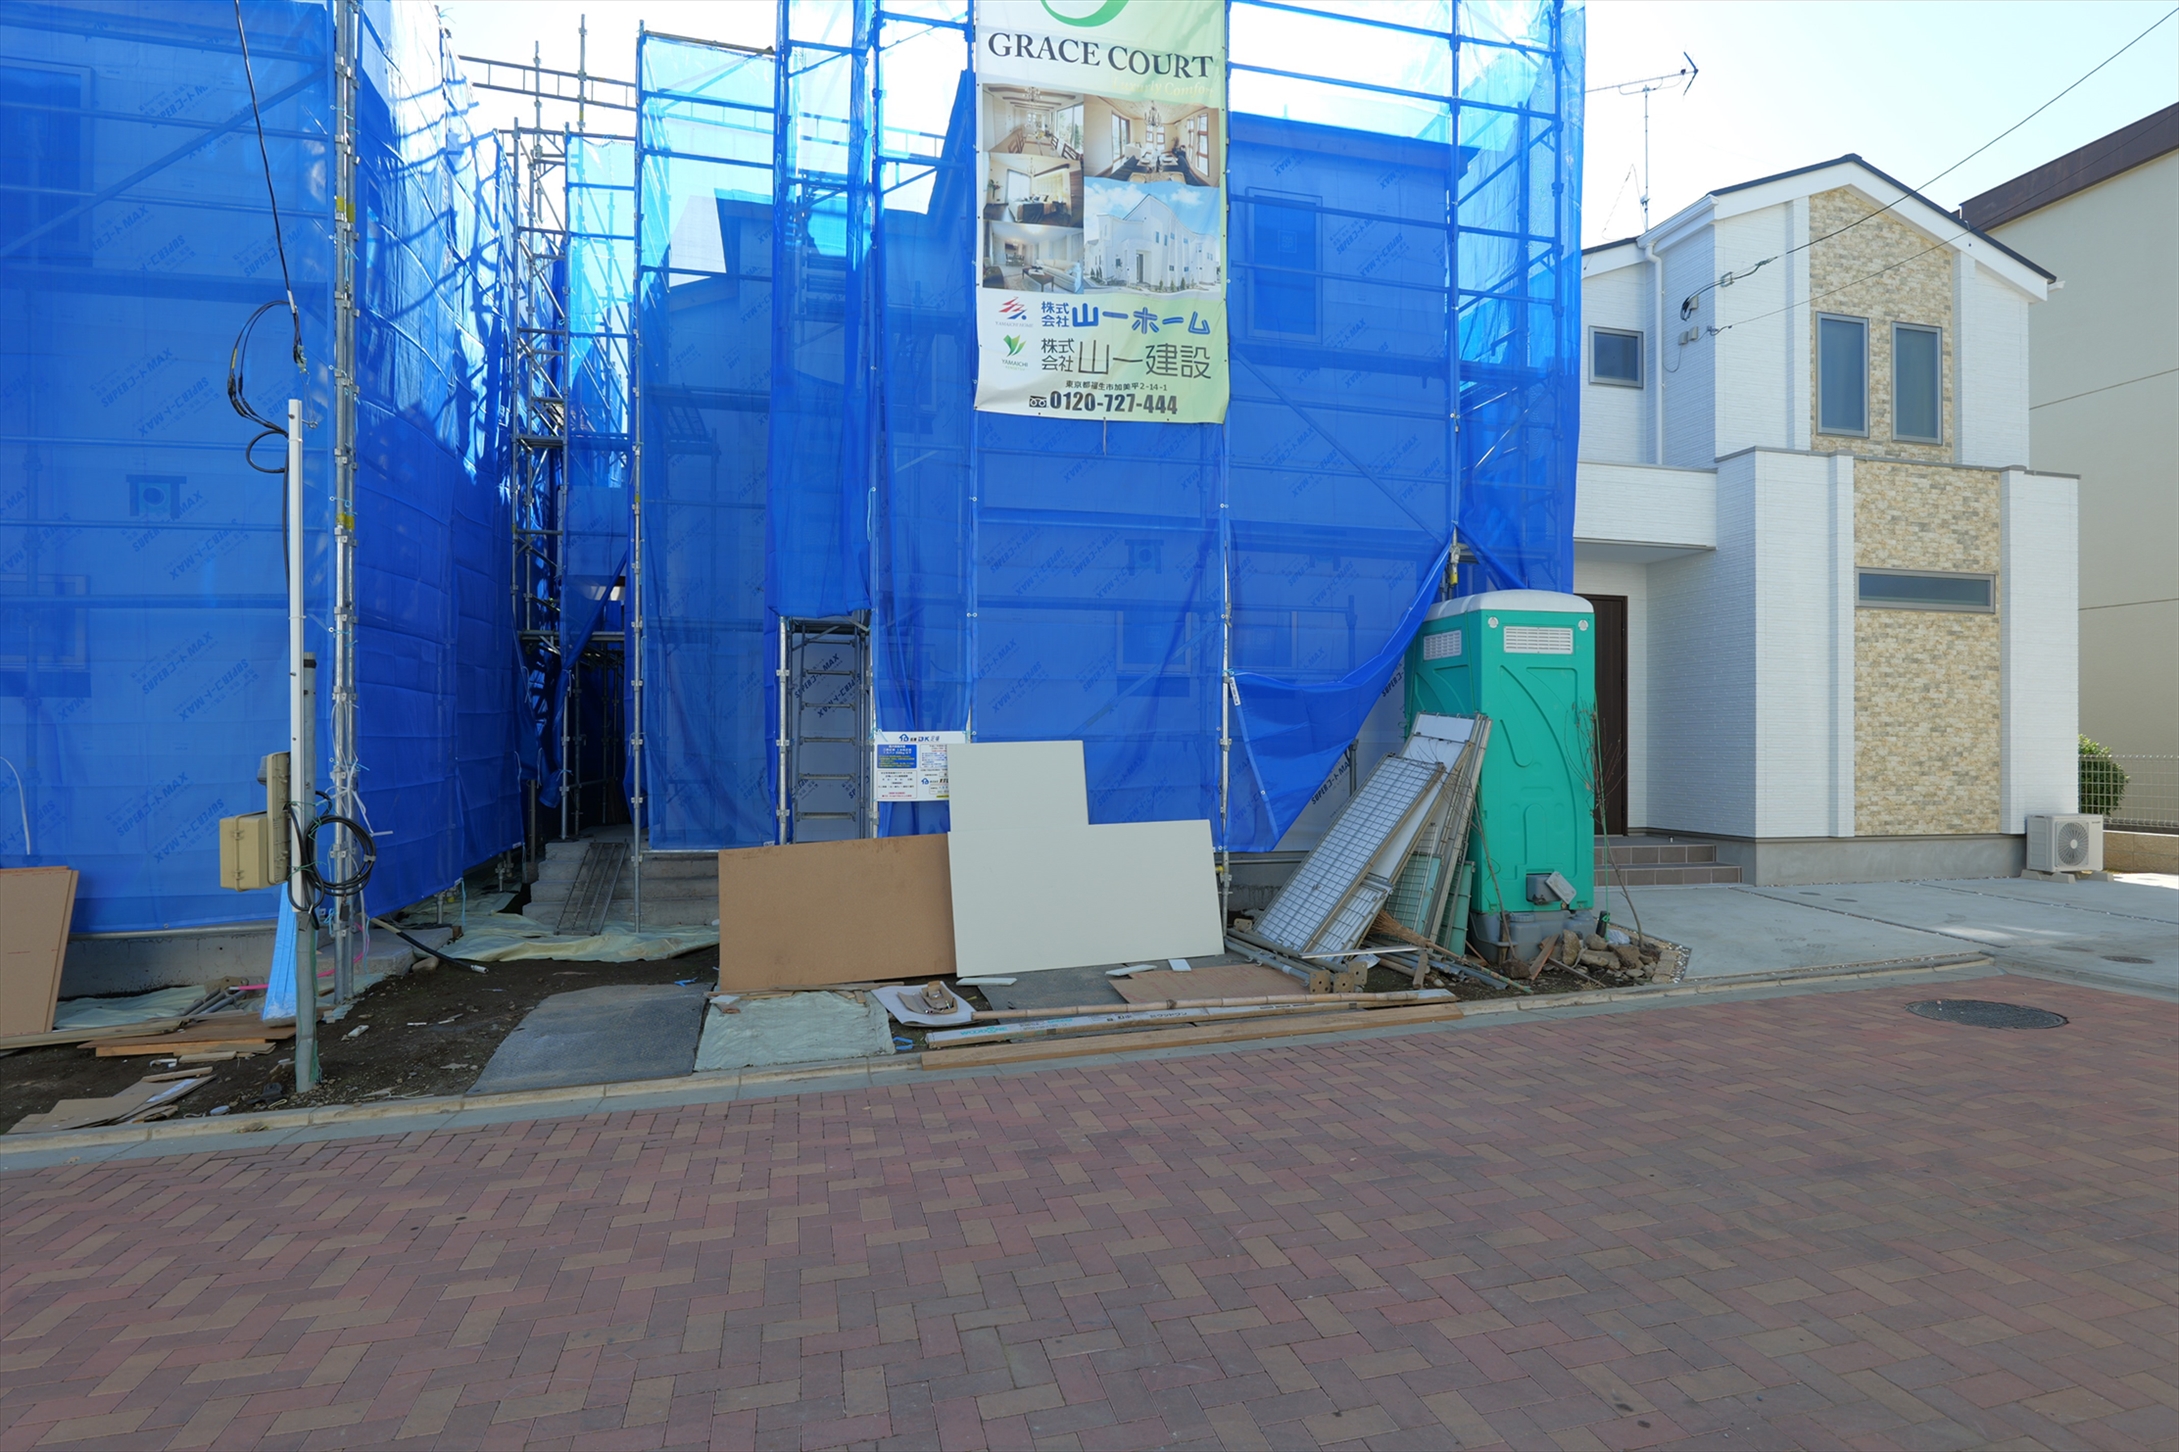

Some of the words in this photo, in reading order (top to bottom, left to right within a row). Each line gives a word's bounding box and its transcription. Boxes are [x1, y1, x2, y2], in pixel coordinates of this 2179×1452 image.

[988, 32, 1101, 66] GRACE
[1107, 46, 1214, 79] COURT
[1164, 81, 1214, 99] Comfort
[1041, 301, 1070, 314] 株式
[1041, 315, 1070, 328] 会社
[1072, 303, 1211, 334] 山一ホーム
[1041, 338, 1075, 354] 株式
[1001, 359, 1028, 368] YAMAICHI
[1041, 355, 1074, 372] 会社
[1078, 340, 1211, 379] 山一建設
[1050, 390, 1178, 415] 0120-727-444
